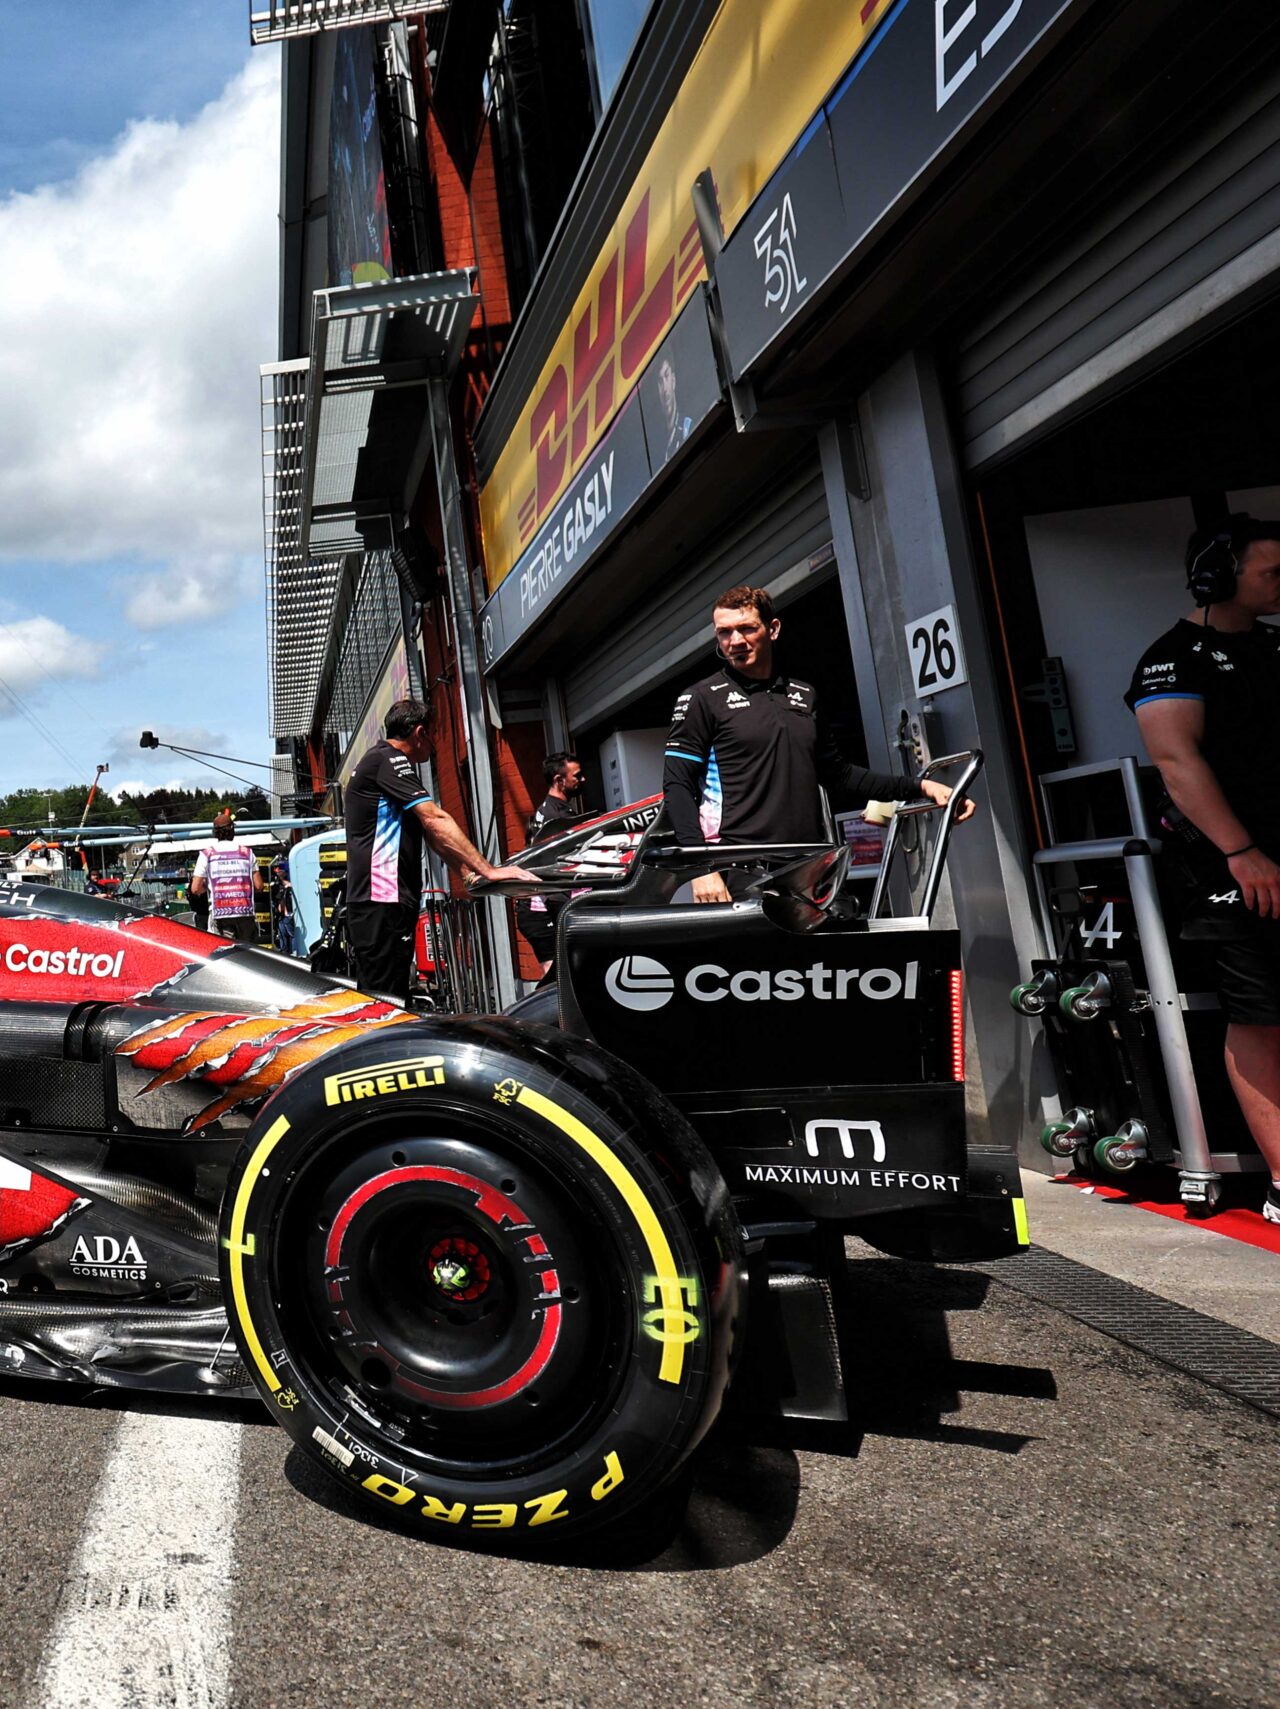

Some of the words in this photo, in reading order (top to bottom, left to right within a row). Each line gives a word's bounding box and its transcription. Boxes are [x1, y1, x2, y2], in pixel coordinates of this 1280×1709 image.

[753, 191, 807, 313] 31
[530, 185, 676, 514] DHL
[520, 527, 562, 617] PIERRE
[563, 450, 615, 560] GASLY
[912, 618, 957, 689] 26
[5, 944, 124, 978] Castrol
[685, 960, 919, 1001] Castrol
[324, 1056, 445, 1106] PIRELLI
[745, 1165, 860, 1186] MAXIMUM
[871, 1170, 961, 1192] EFFORT
[72, 1235, 144, 1264] ADA
[72, 1267, 147, 1280] COSMETICS
[348, 1441, 380, 1469] 31301
[590, 1450, 625, 1501] P
[362, 1473, 570, 1529] ZERO
